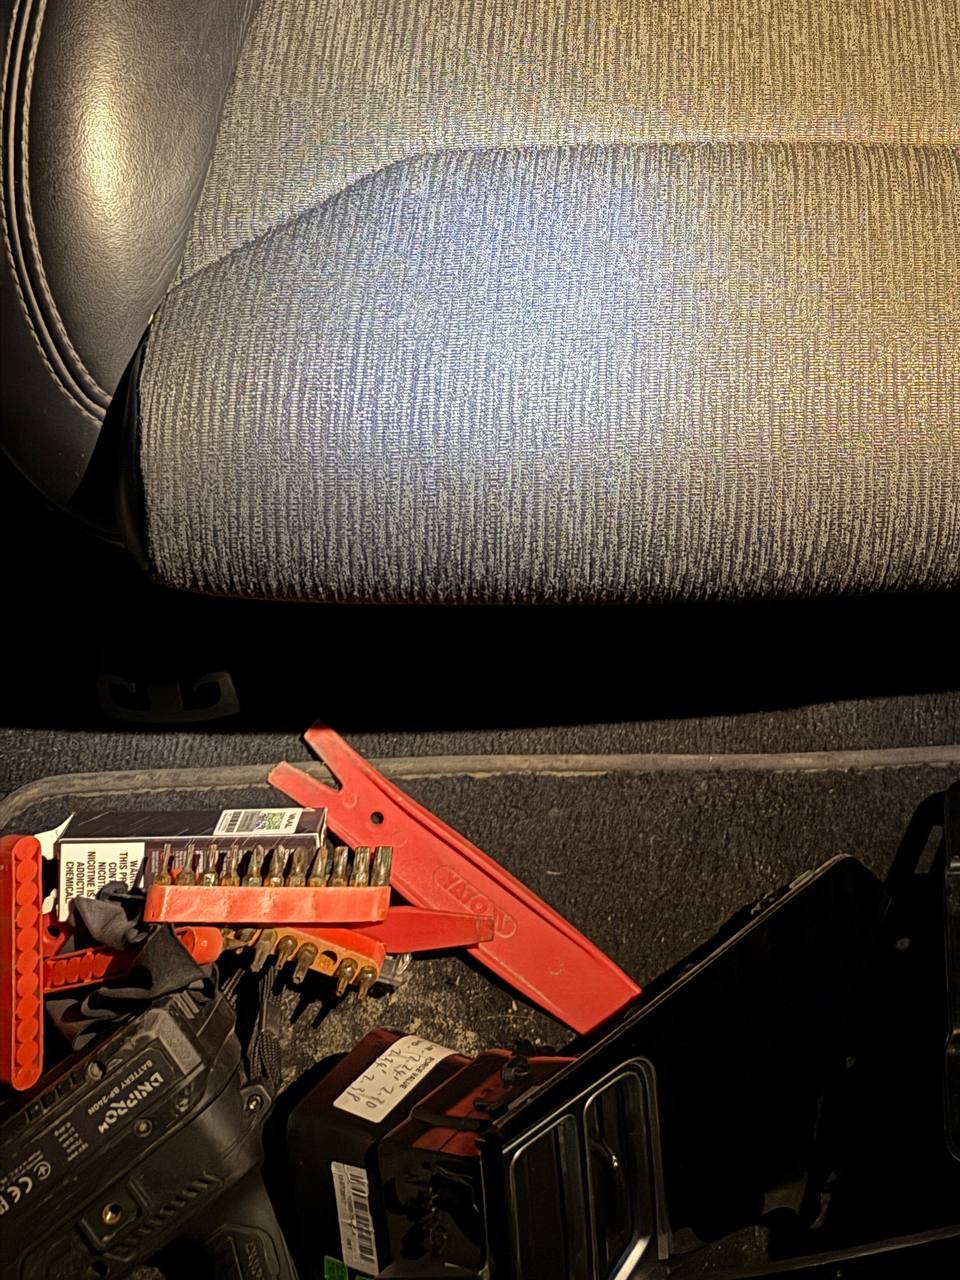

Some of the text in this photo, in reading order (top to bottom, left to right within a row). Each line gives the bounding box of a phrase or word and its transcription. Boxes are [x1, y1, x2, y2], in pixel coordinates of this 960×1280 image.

[87, 851, 96, 898] NICOTINE IS
[119, 852, 128, 870] THIS
[121, 1059, 153, 1089] BATTERY
[399, 1056, 435, 1090] FORCE VALUE
